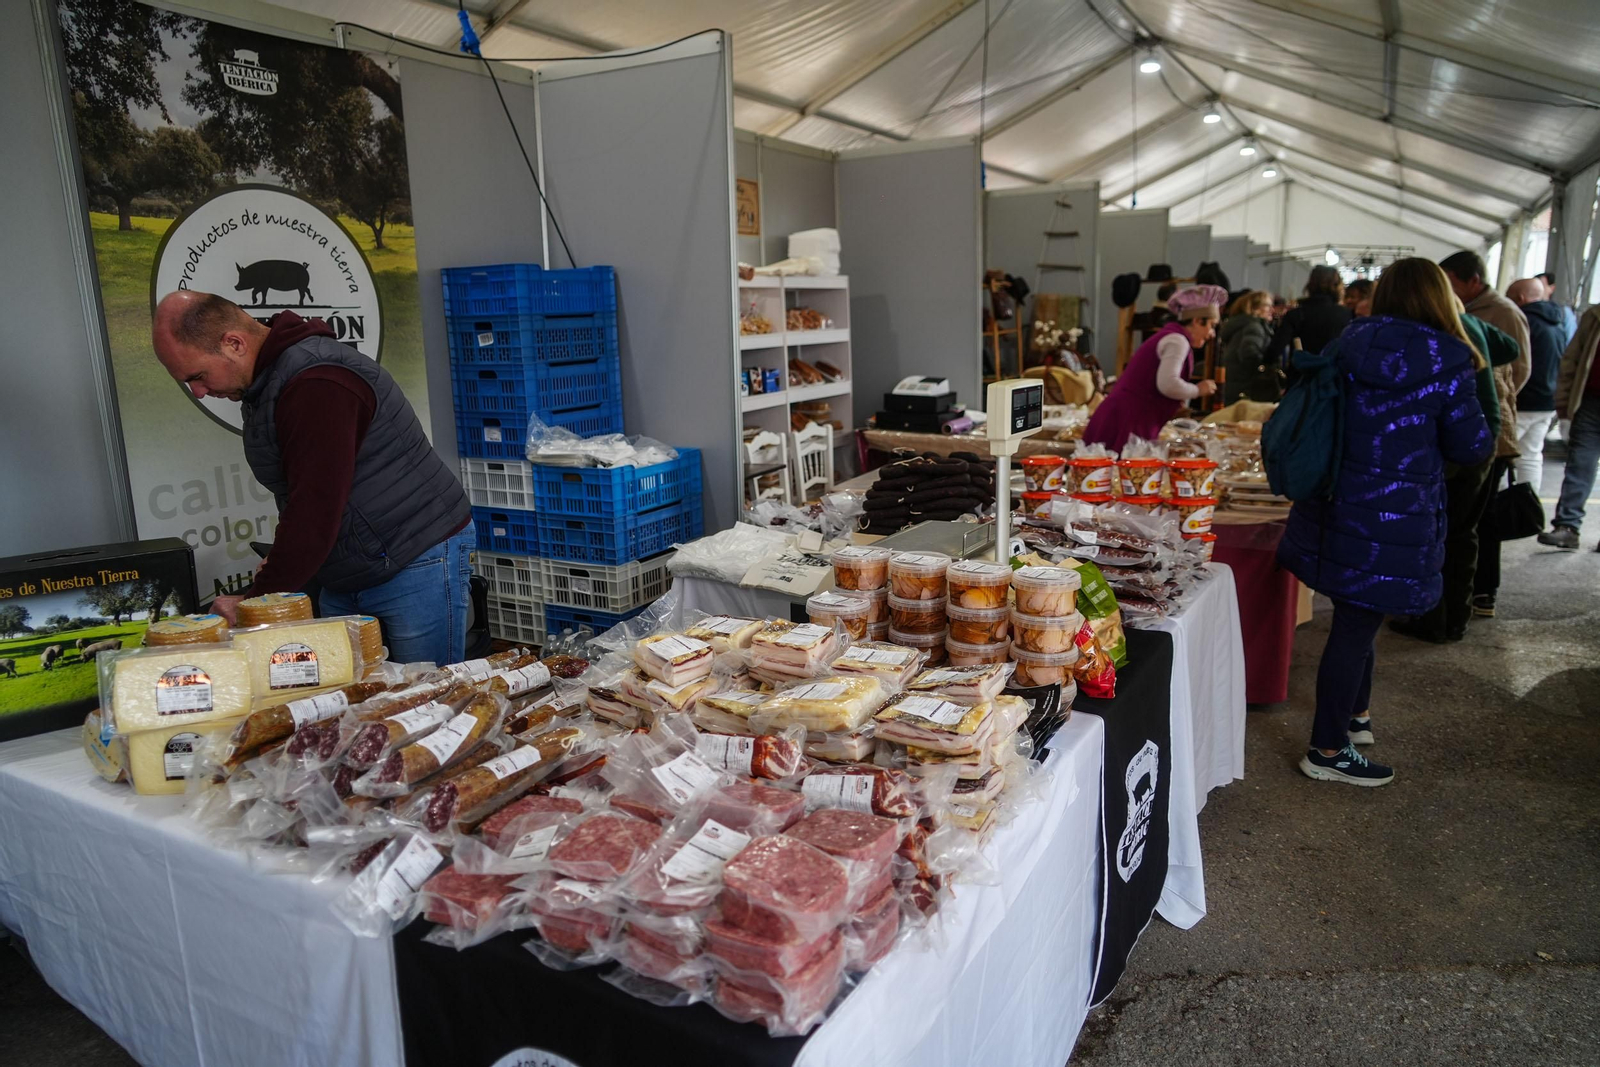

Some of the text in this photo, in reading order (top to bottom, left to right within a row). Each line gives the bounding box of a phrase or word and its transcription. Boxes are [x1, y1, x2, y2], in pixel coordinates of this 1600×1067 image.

[218, 62, 279, 84] TENTACIÓN
[178, 208, 359, 294] Productos de nuestra tierra
[182, 514, 268, 550] color
[19, 581, 37, 596] de
[41, 574, 95, 595] Nuestra
[98, 569, 140, 587] Tierra
